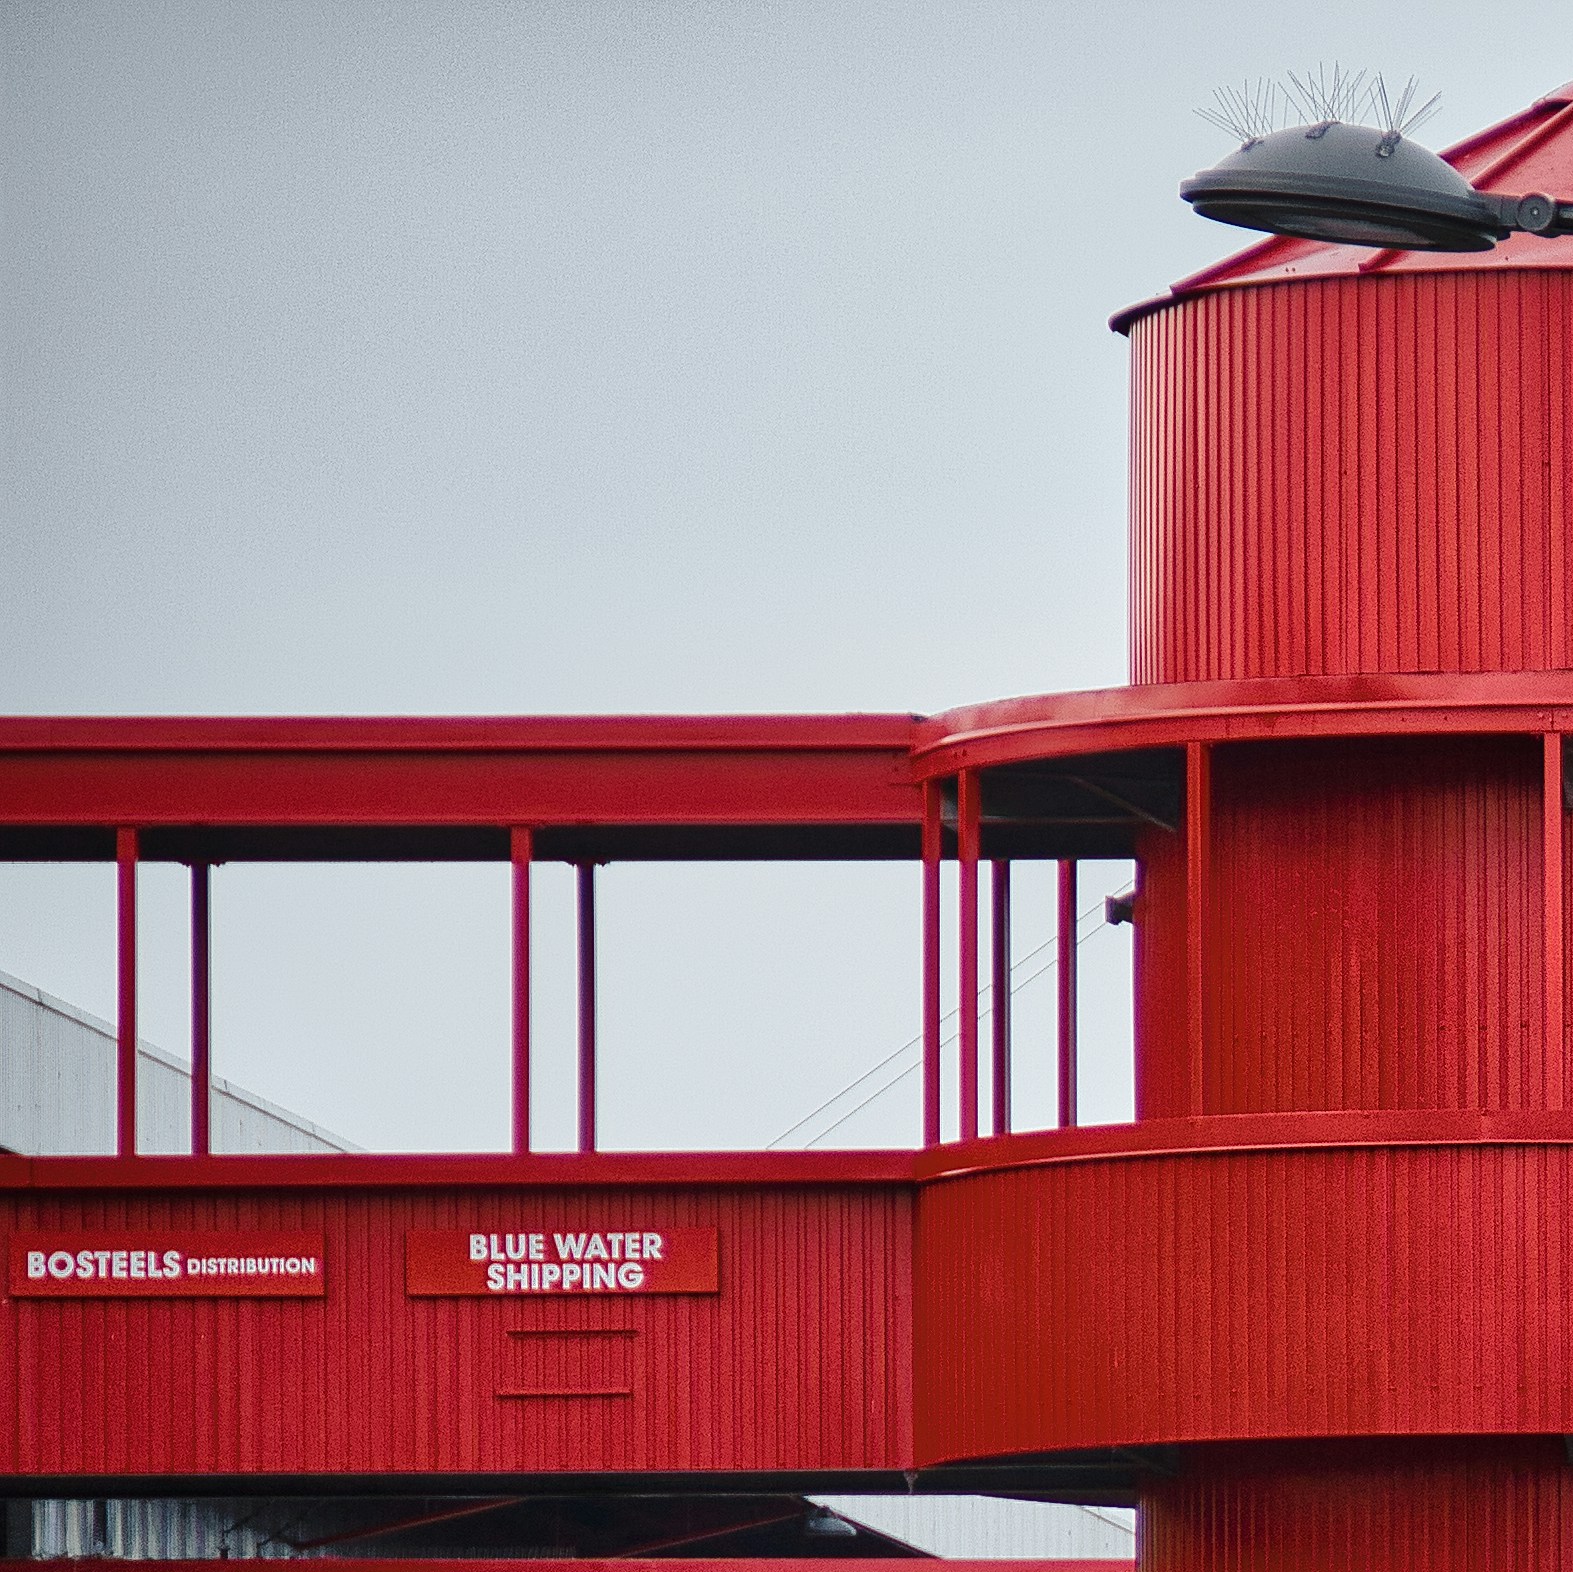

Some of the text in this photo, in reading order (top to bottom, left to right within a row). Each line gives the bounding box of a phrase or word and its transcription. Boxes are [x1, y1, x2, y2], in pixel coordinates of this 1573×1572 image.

[469, 1232, 662, 1260] BLUE WATER
[27, 1251, 316, 1278] BOSTEELS DISTRIBUTION
[486, 1261, 645, 1290] SHIPPING
